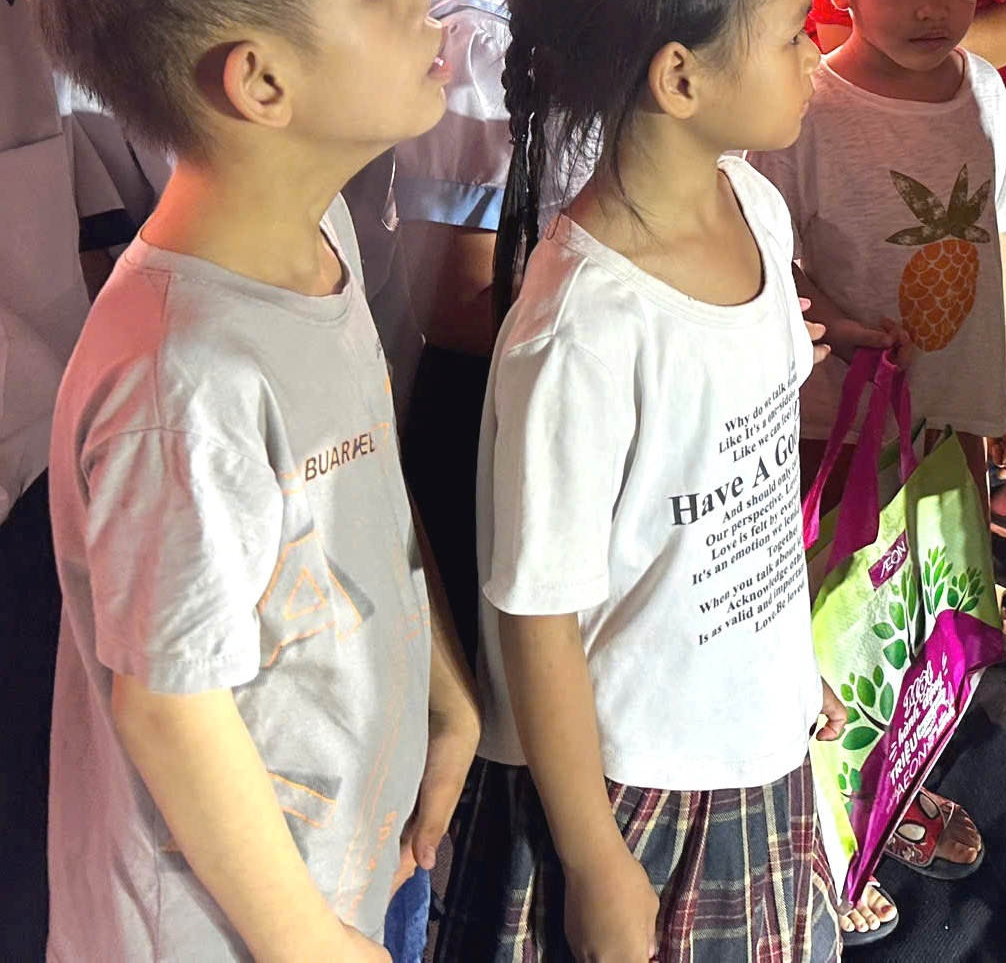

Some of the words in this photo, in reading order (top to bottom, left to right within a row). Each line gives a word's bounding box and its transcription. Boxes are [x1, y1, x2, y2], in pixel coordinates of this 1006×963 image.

[724, 413, 750, 433] Why
[753, 406, 763, 419] do
[772, 382, 786, 401] talk
[718, 433, 742, 454] Like
[745, 424, 760, 440] It's
[732, 442, 757, 462] Like
[758, 434, 769, 447] we
[770, 421, 781, 438] can
[667, 475, 744, 526] Have
[752, 456, 770, 488] A
[722, 500, 743, 524] And
[746, 479, 776, 509] should
[778, 468, 791, 485] only
[706, 527, 729, 547] Our
[731, 493, 783, 536] perspective.
[711, 539, 737, 561] Love
[739, 532, 748, 544] is
[751, 520, 767, 537] felt
[769, 513, 778, 525] by
[692, 570, 712, 586] It's
[714, 560, 728, 574] an
[730, 533, 770, 564] emotion
[772, 523, 782, 537] we
[699, 590, 730, 614] When
[732, 577, 753, 597] you
[756, 562, 773, 582] talk
[775, 542, 796, 567] about
[727, 566, 788, 613] Acknowledge
[698, 634, 709, 646] Is
[711, 624, 722, 637] as
[725, 606, 754, 628] valid
[757, 592, 772, 614] and
